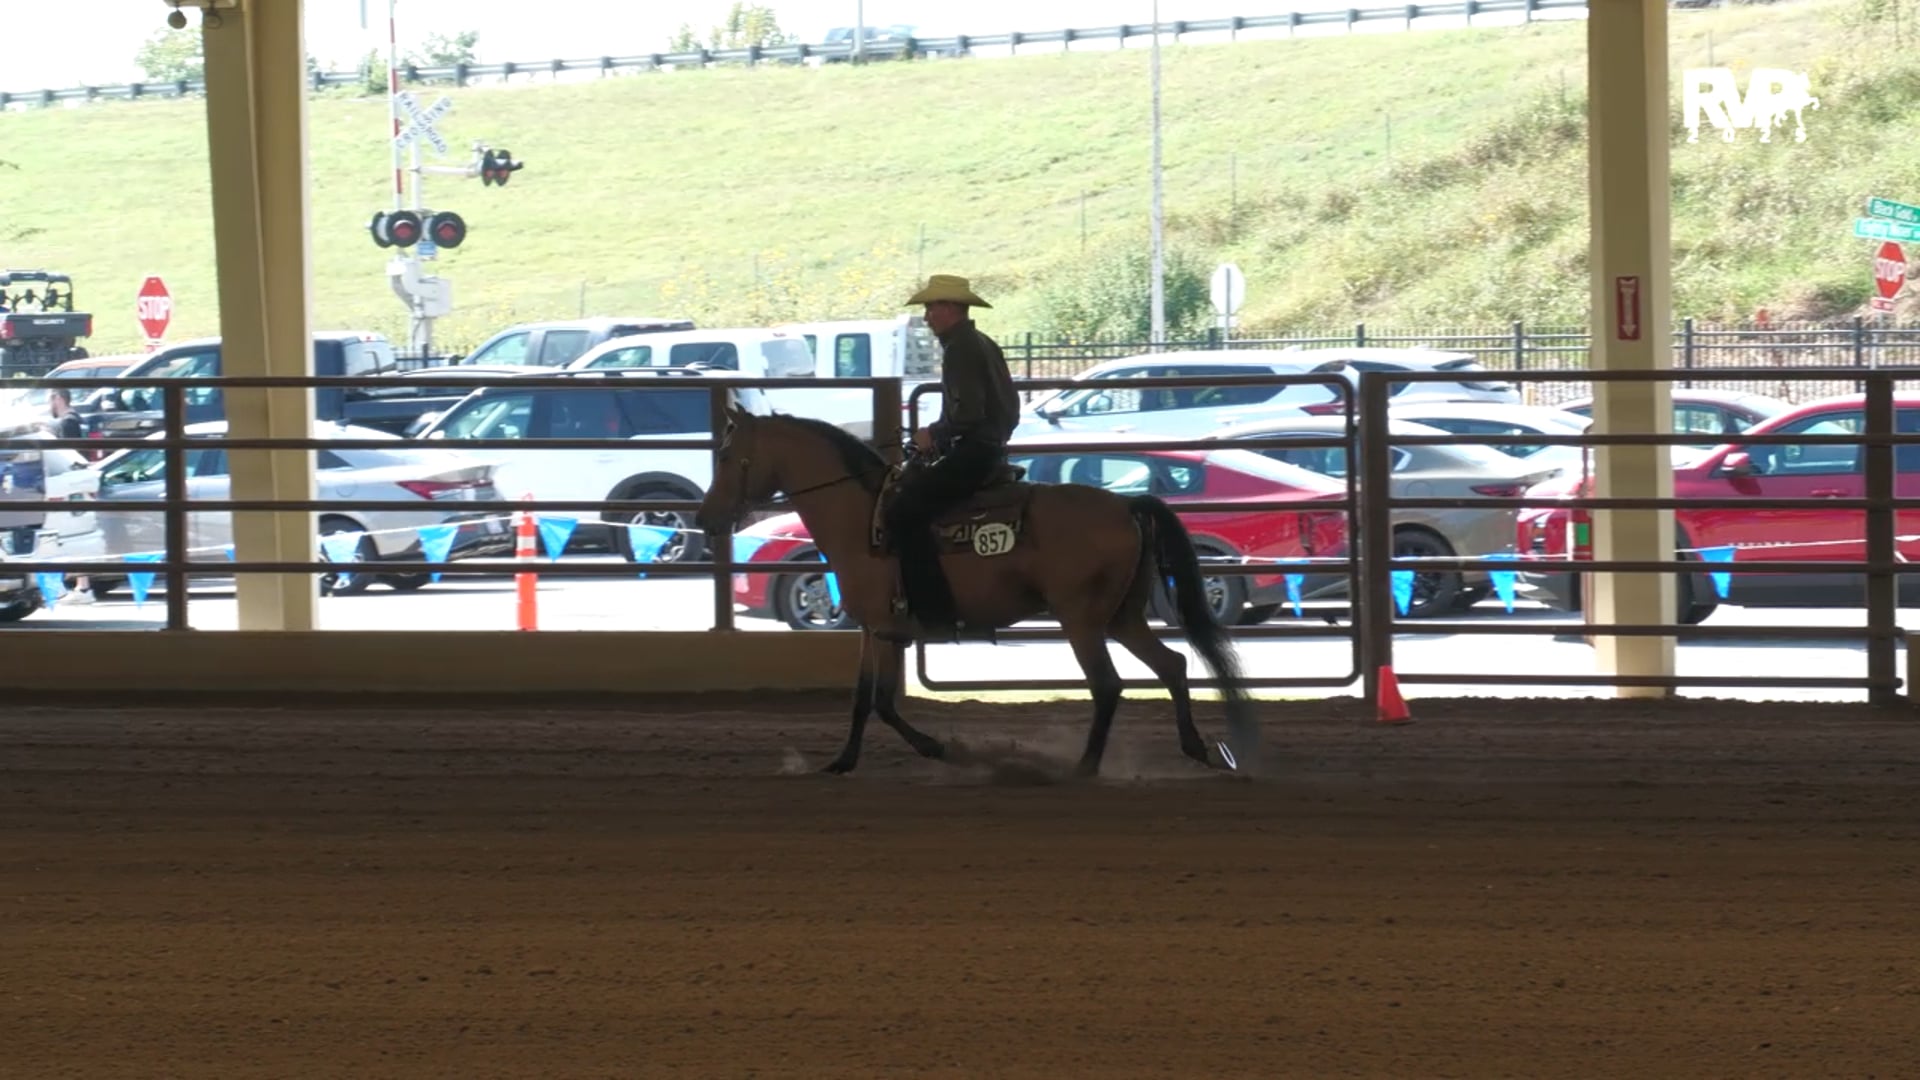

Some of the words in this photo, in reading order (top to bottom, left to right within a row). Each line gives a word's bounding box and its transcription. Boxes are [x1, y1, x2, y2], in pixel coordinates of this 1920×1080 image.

[1874, 257, 1905, 283] STOP
[139, 296, 170, 320] STOP
[978, 529, 1008, 554] 857
